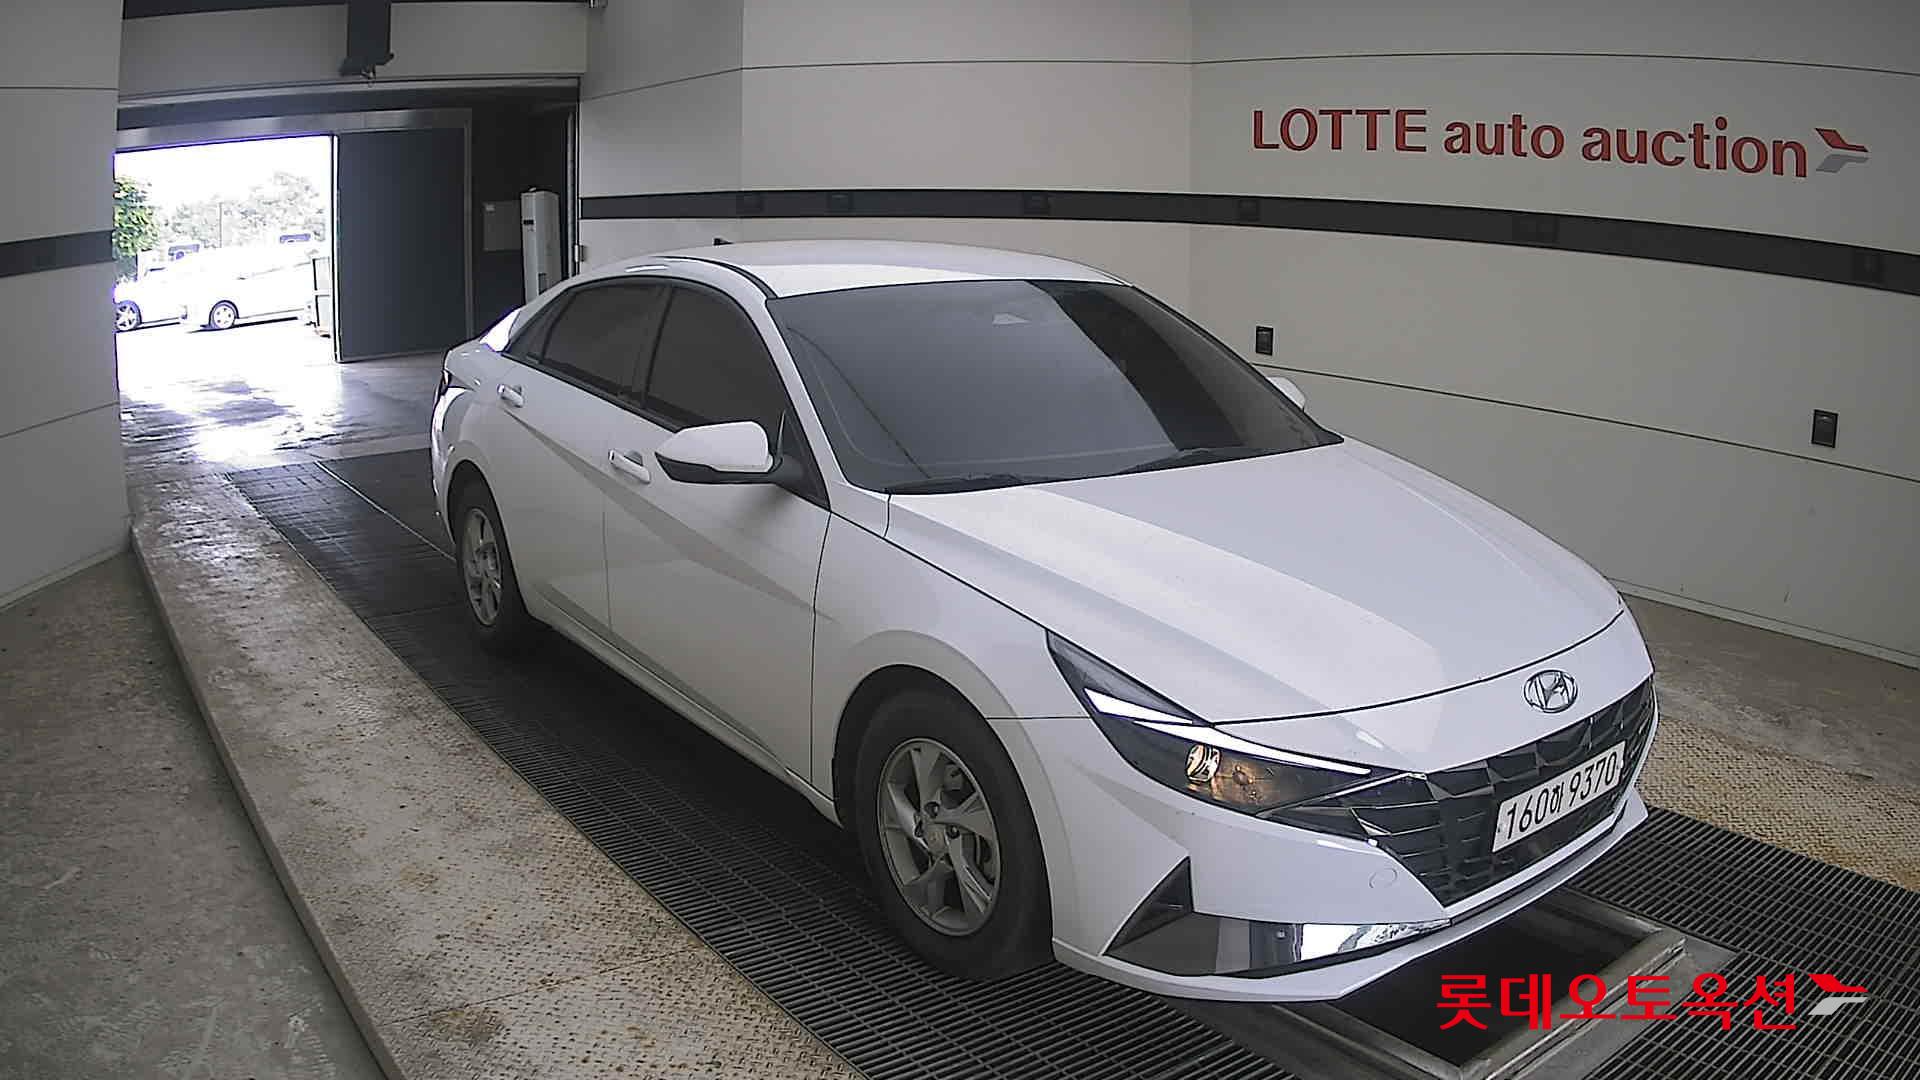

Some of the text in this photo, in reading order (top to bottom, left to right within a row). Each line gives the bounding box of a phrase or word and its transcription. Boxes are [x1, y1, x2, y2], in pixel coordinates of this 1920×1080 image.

[1252, 108, 1808, 178] LOTTE auto auction
[1569, 751, 1617, 807] 9370
